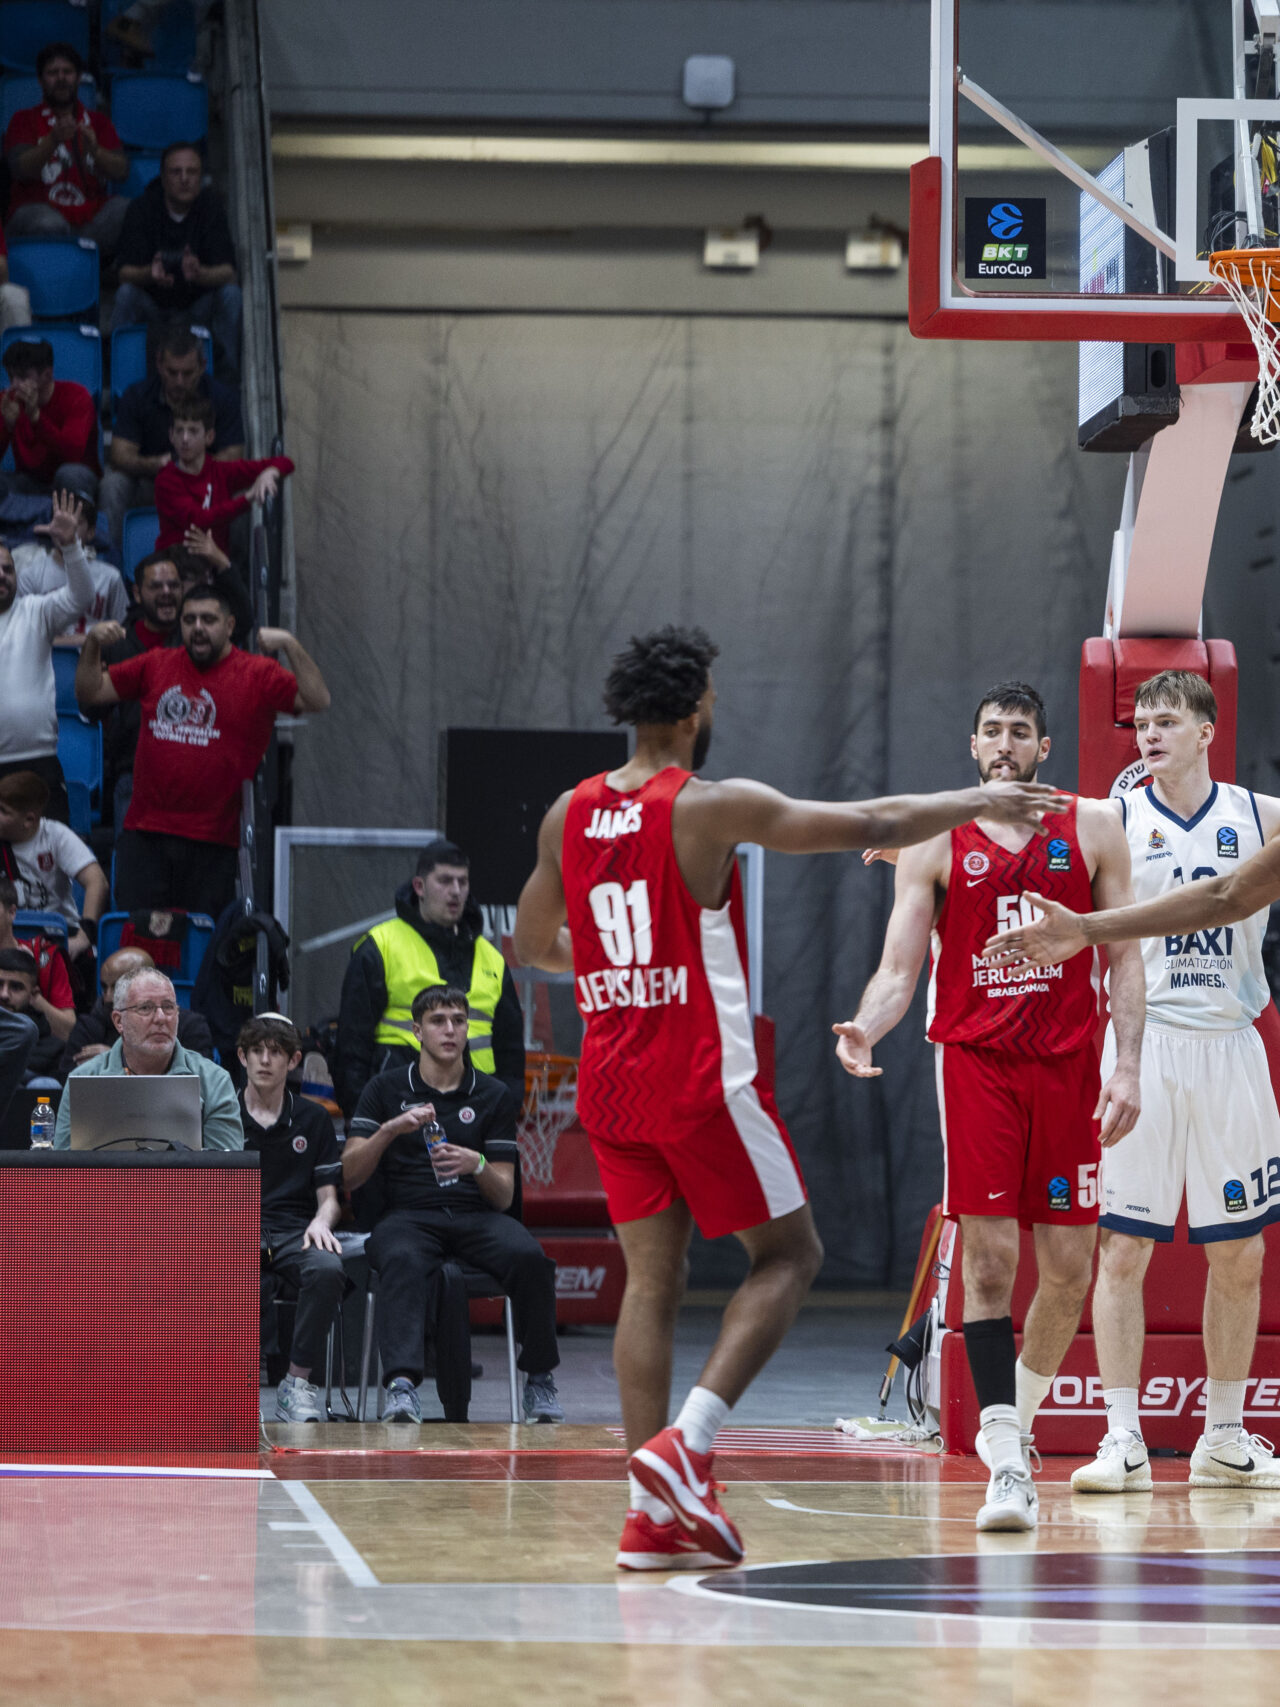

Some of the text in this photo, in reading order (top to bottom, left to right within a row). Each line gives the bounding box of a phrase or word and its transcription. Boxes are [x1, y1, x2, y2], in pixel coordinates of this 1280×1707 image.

[983, 247, 1027, 258] BKT
[978, 263, 1032, 277] EuroCup
[1118, 763, 1145, 790] שלים
[588, 879, 653, 967] 91
[1164, 927, 1234, 957] BAXI
